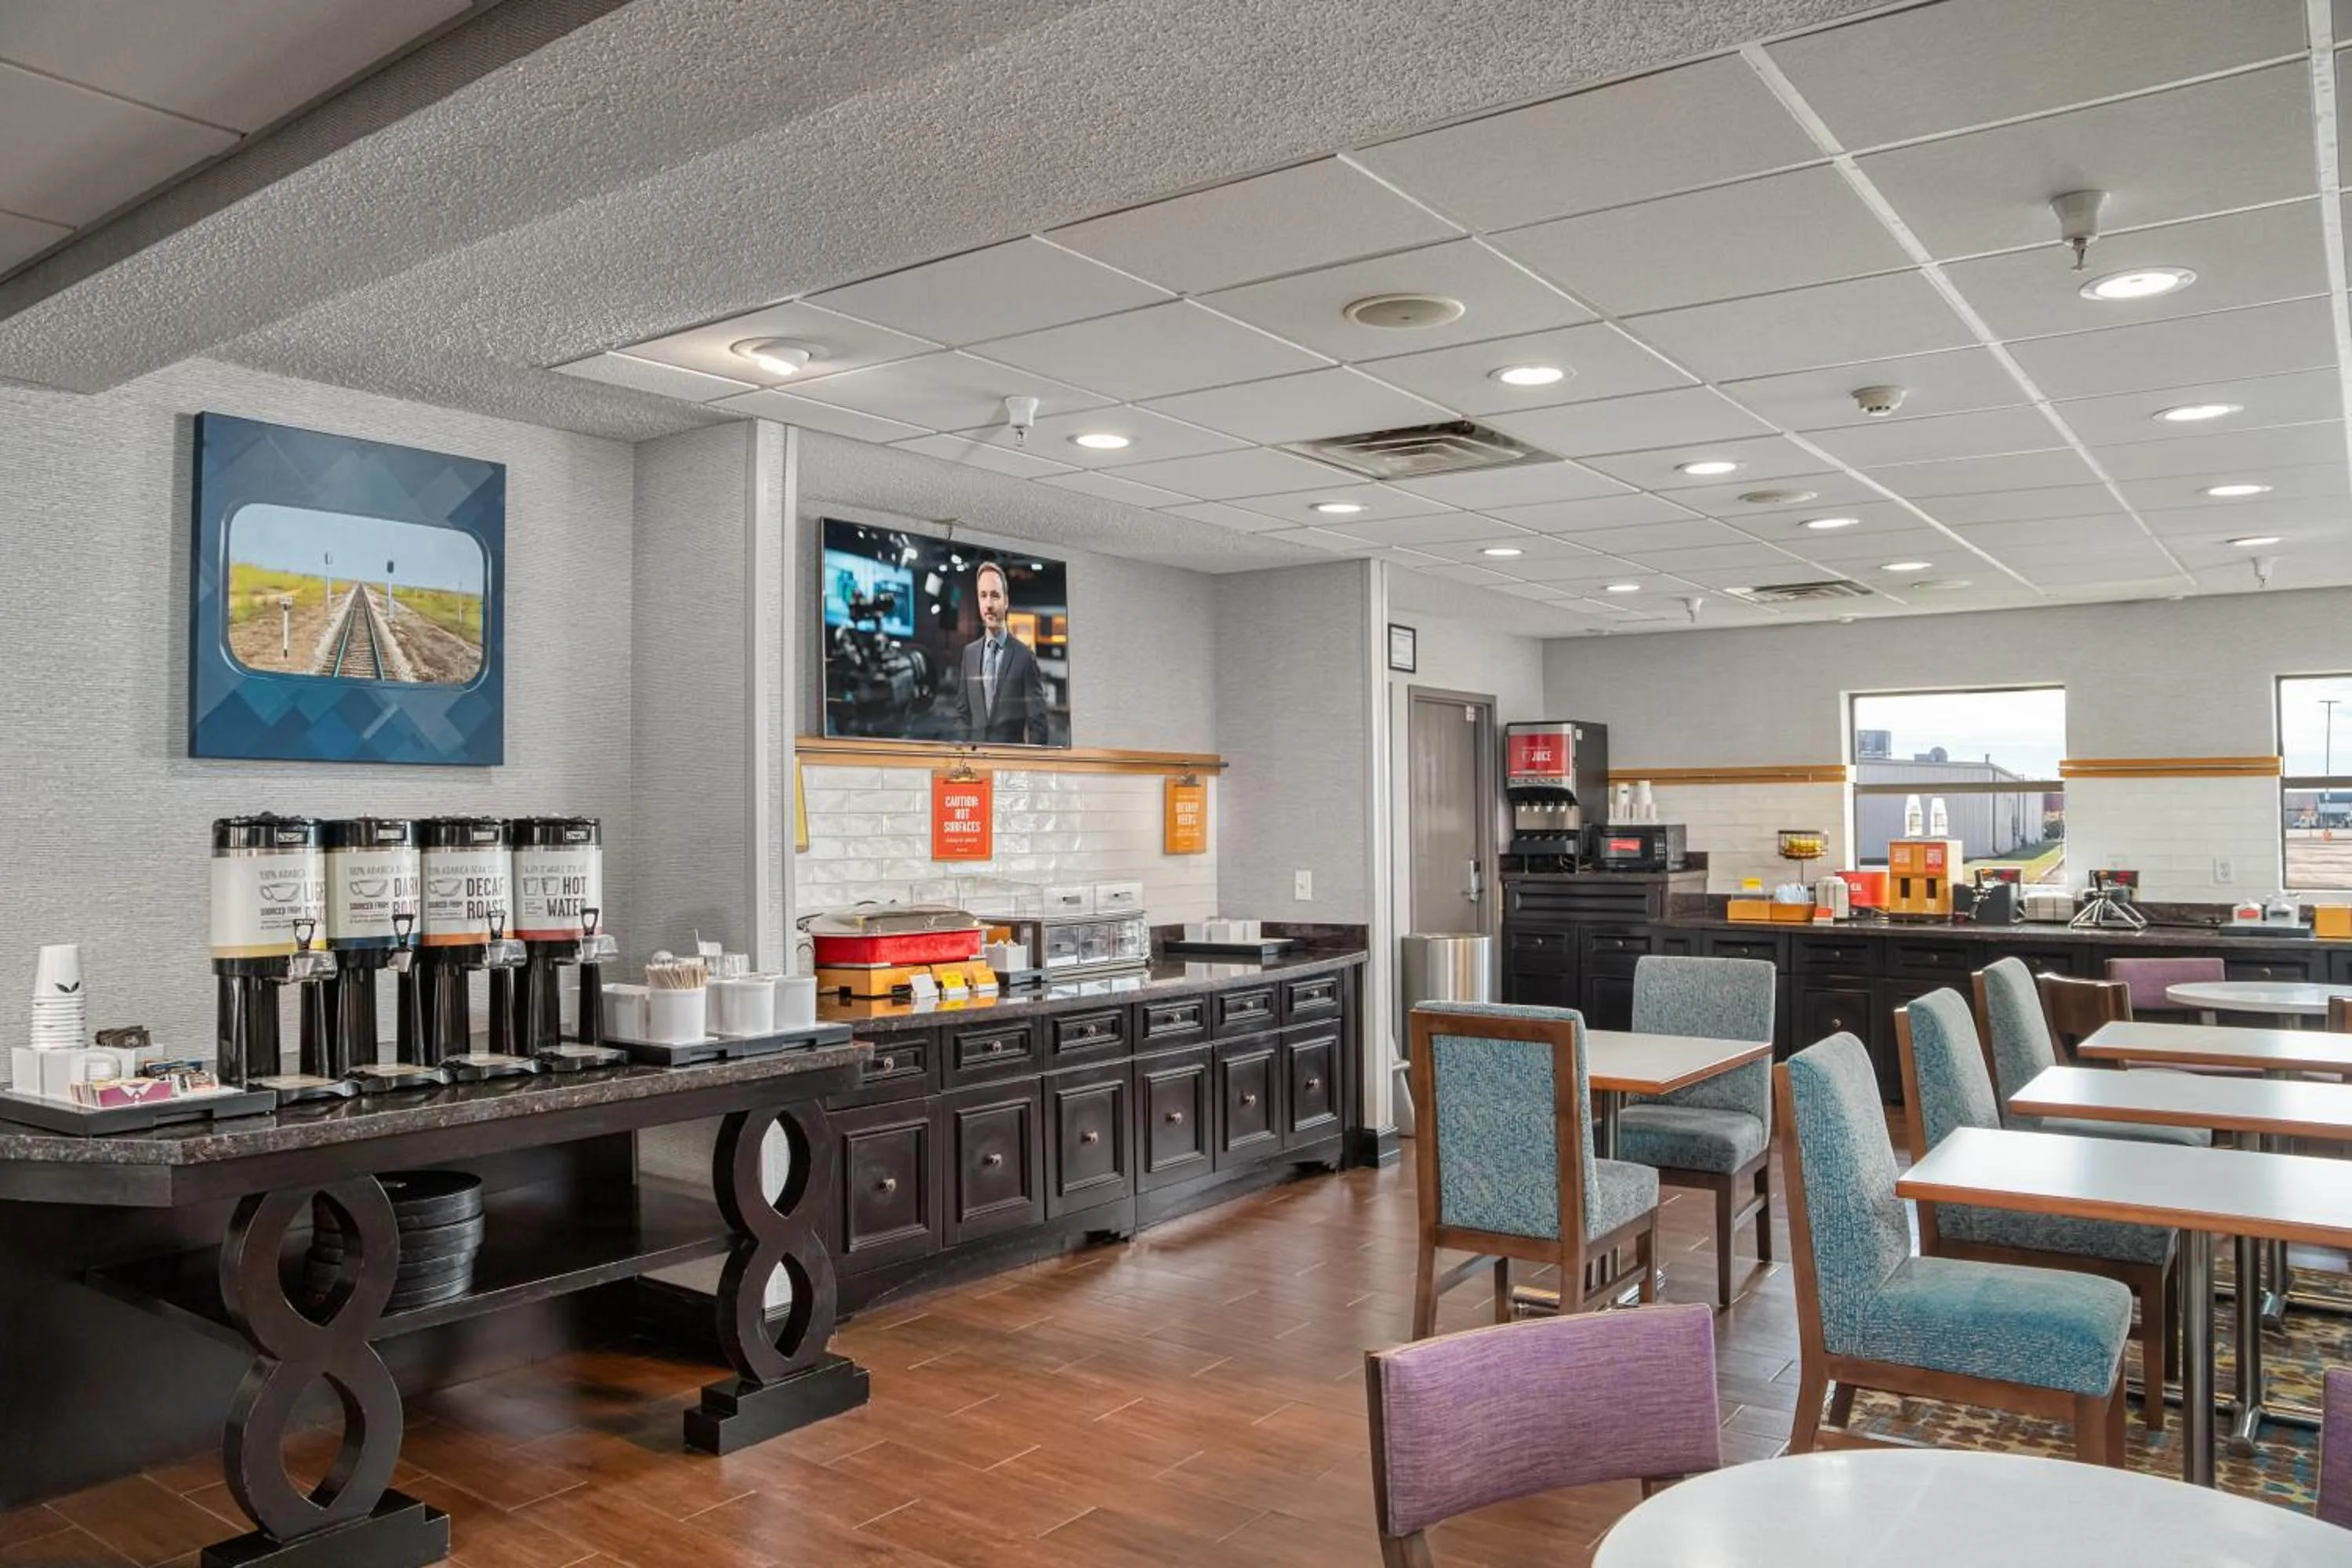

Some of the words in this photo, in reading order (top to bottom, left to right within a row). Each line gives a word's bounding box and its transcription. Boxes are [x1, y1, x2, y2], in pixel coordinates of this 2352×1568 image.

[1531, 750, 1552, 761] JUICE
[945, 796, 978, 807] CAUTION
[954, 808, 970, 819] HOT
[943, 821, 981, 833] SURFACES
[466, 877, 503, 898] DECAF
[563, 877, 587, 895] HOT
[466, 899, 504, 920] ROAST
[546, 898, 587, 917] WATER
